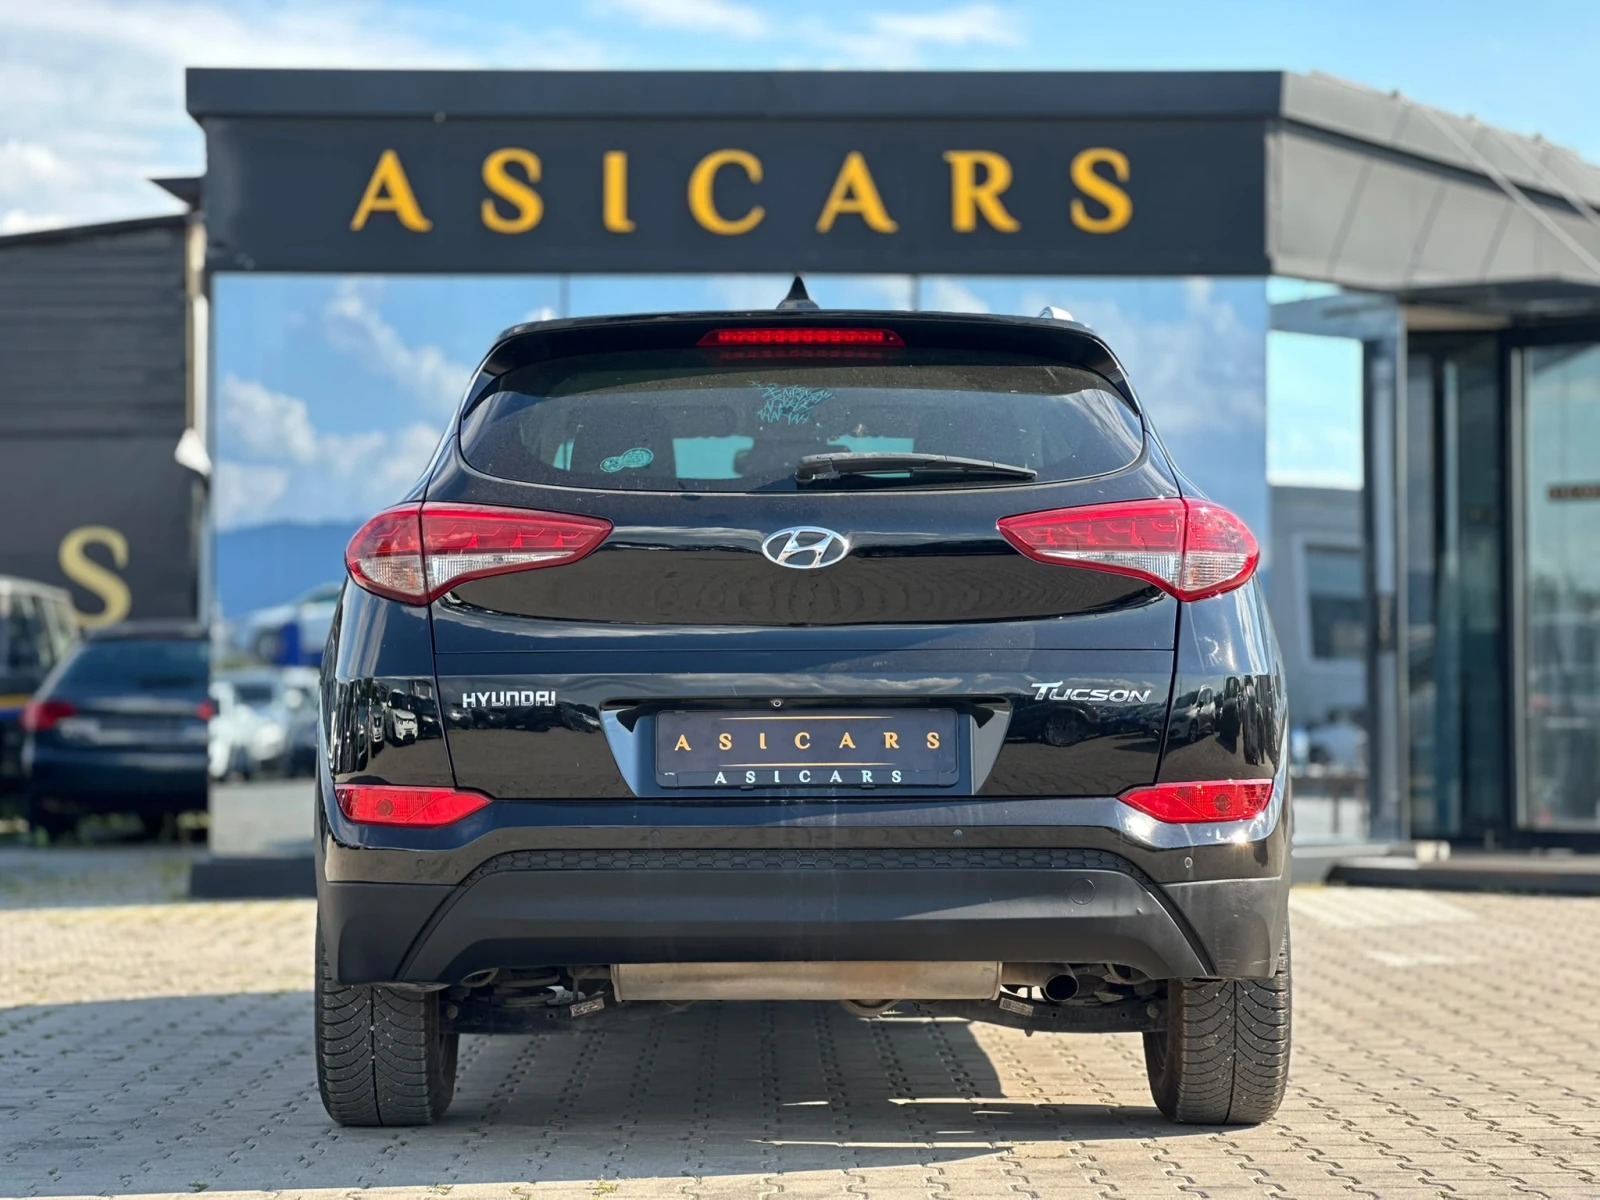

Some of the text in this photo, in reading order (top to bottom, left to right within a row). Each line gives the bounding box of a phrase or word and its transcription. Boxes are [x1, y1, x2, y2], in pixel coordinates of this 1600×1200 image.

[350, 147, 1134, 236] ASICARS
[462, 690, 556, 708] HYUNDAI
[674, 731, 941, 751] ASICARS
[713, 769, 904, 785] ASICARS
